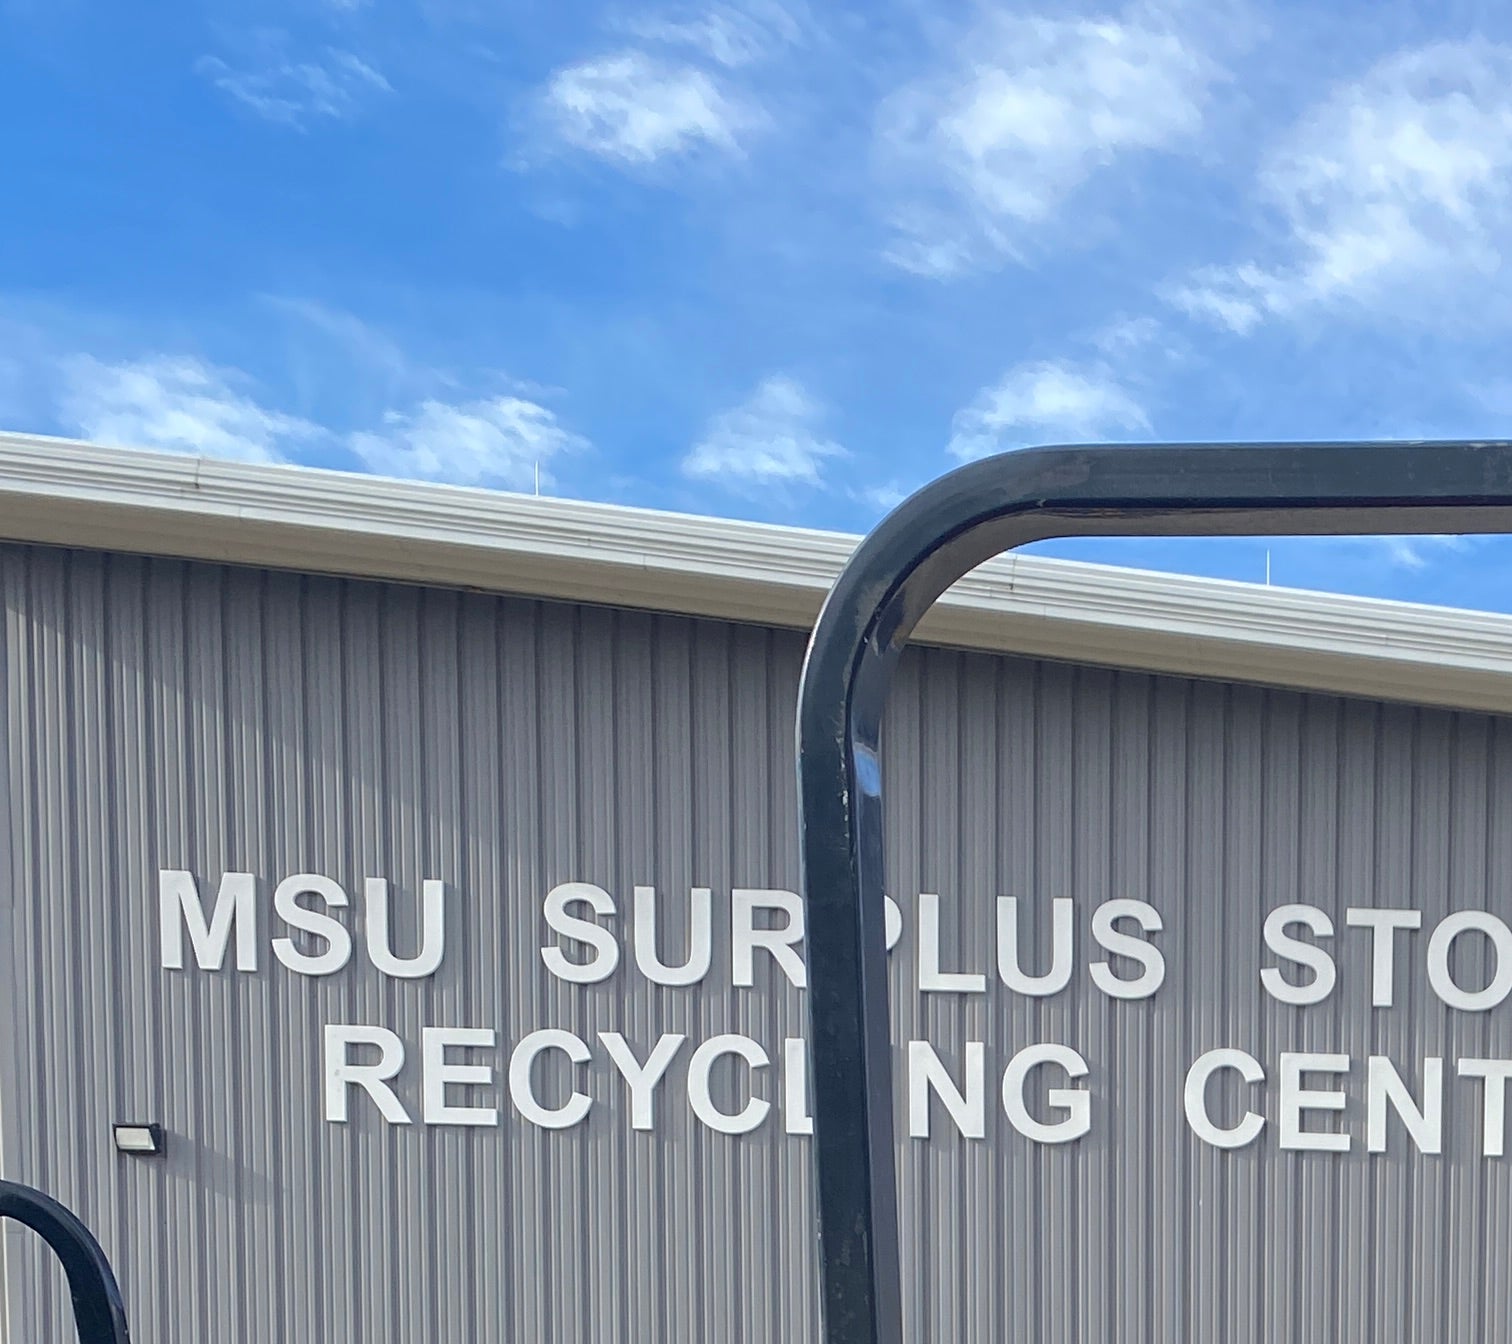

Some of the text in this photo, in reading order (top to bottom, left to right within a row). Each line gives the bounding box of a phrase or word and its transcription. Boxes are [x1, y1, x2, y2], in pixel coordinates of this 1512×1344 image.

[159, 868, 445, 979] MSU
[541, 882, 1167, 1000] SURLUS
[323, 1023, 1092, 1144] RECYCLNG
